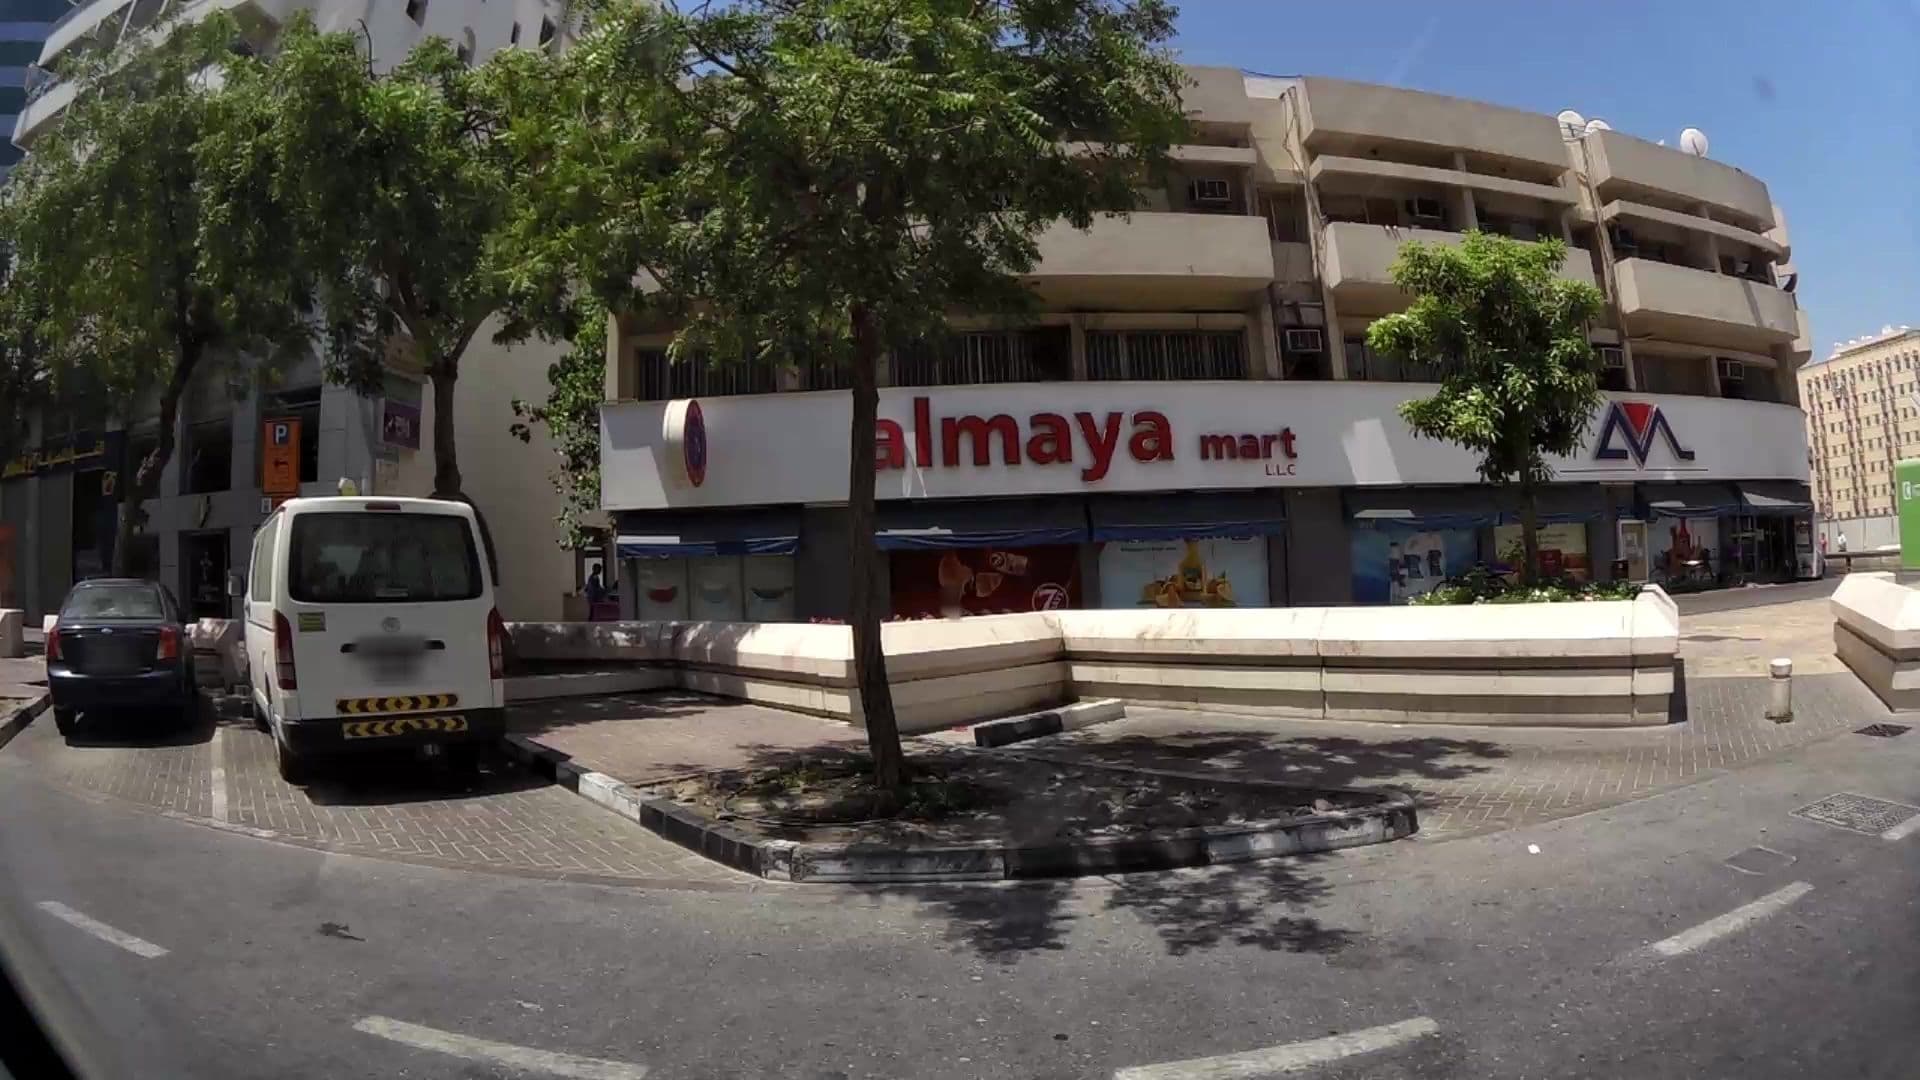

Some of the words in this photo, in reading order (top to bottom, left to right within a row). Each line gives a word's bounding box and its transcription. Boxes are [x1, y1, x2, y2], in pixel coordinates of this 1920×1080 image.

[275, 424, 288, 444] P
[874, 397, 1175, 482] almaya
[1199, 427, 1297, 460] mart
